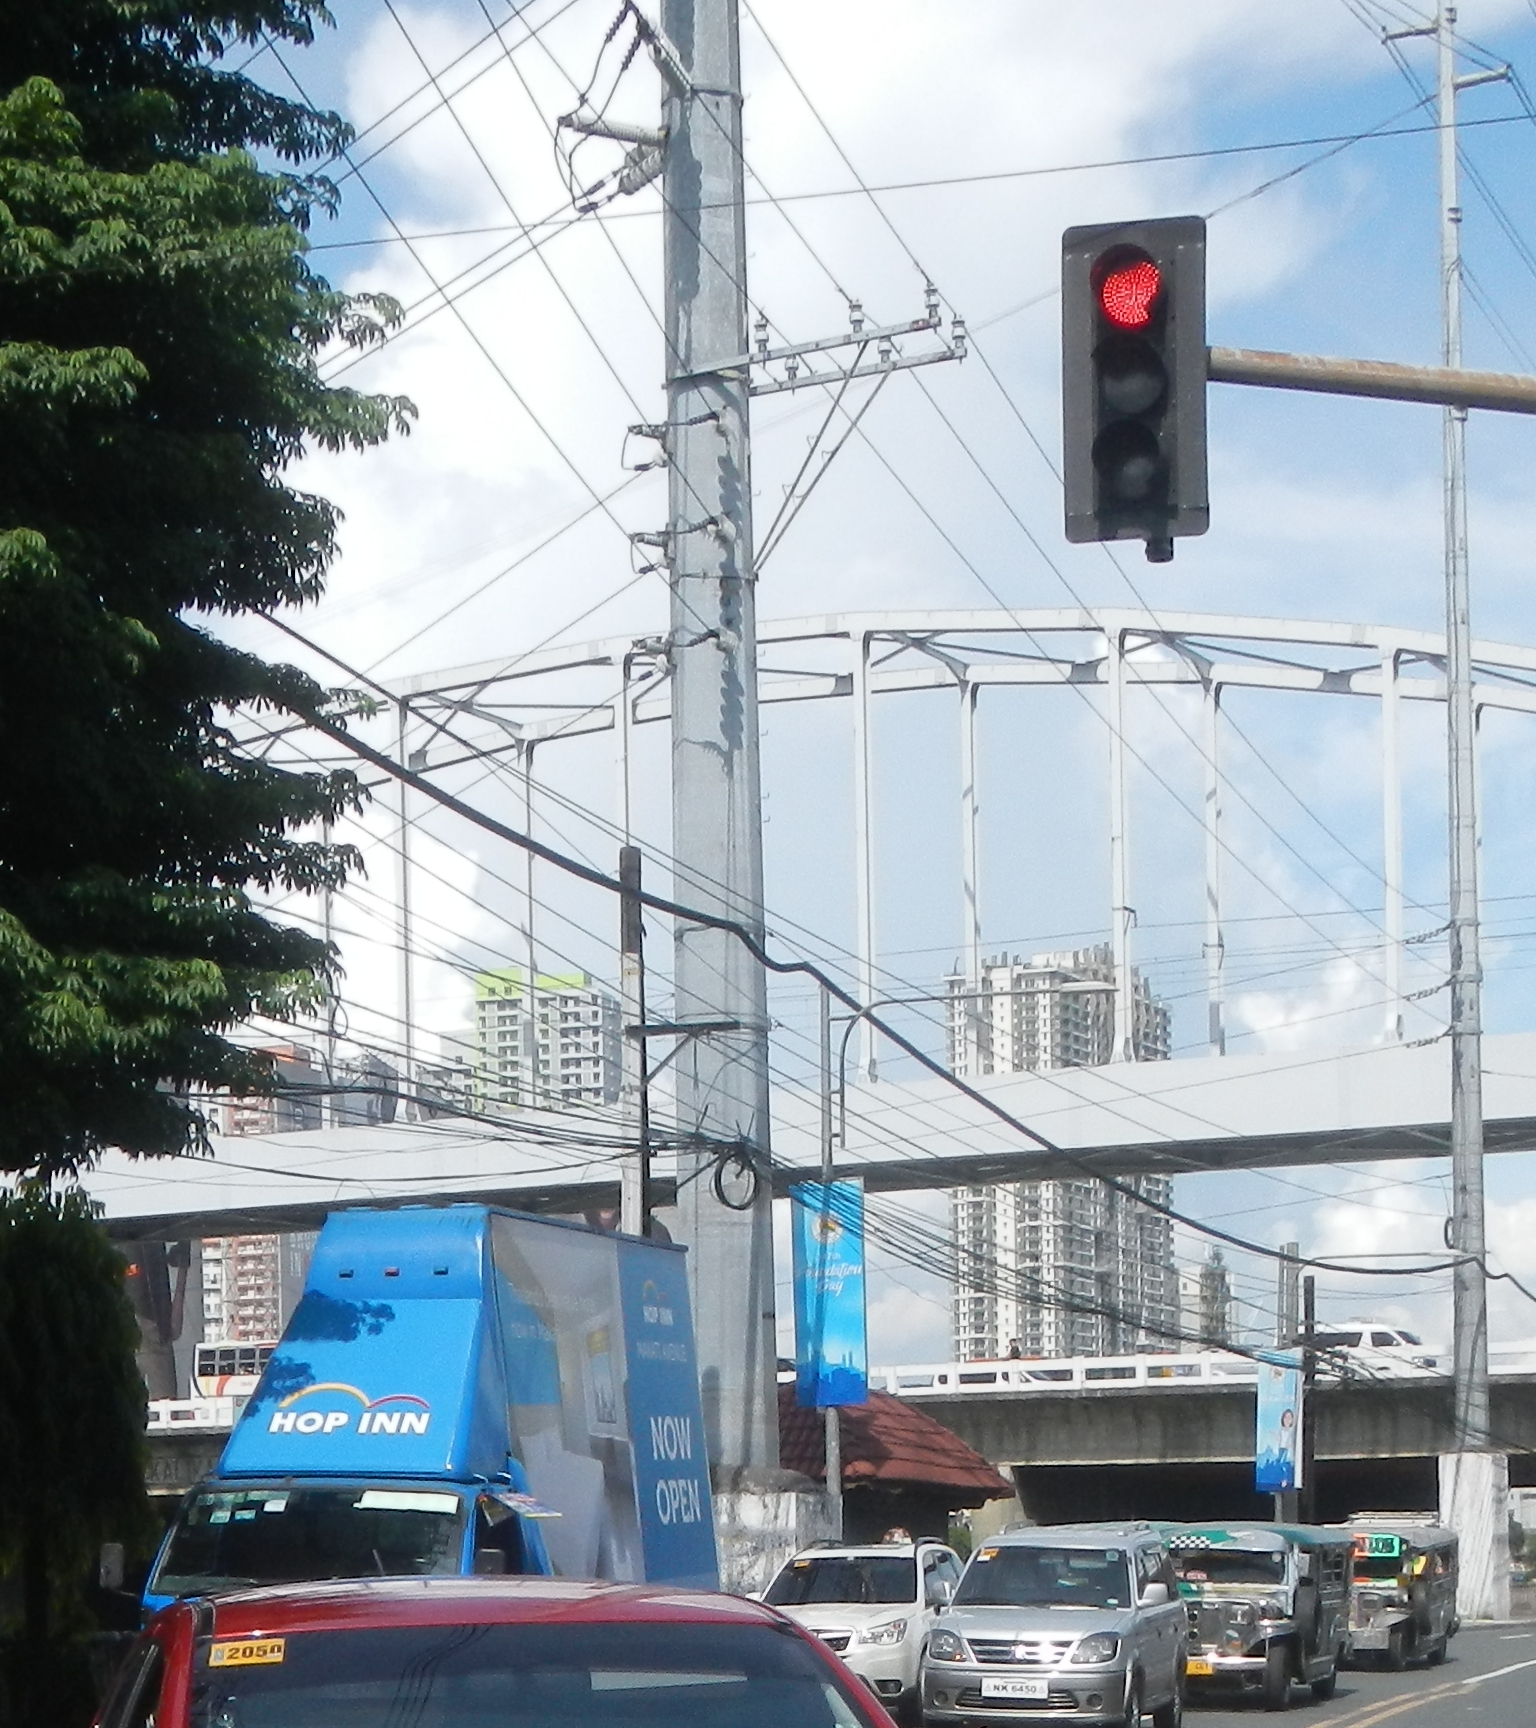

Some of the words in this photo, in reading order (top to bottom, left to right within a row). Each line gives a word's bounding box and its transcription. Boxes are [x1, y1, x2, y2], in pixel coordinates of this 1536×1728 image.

[268, 1411, 350, 1434] HOP
[356, 1411, 431, 1436] INN
[650, 1415, 692, 1461] NOW
[655, 1478, 702, 1526] OPEN
[226, 1644, 282, 1660] 2050
[1011, 1685, 1037, 1694] 6450
